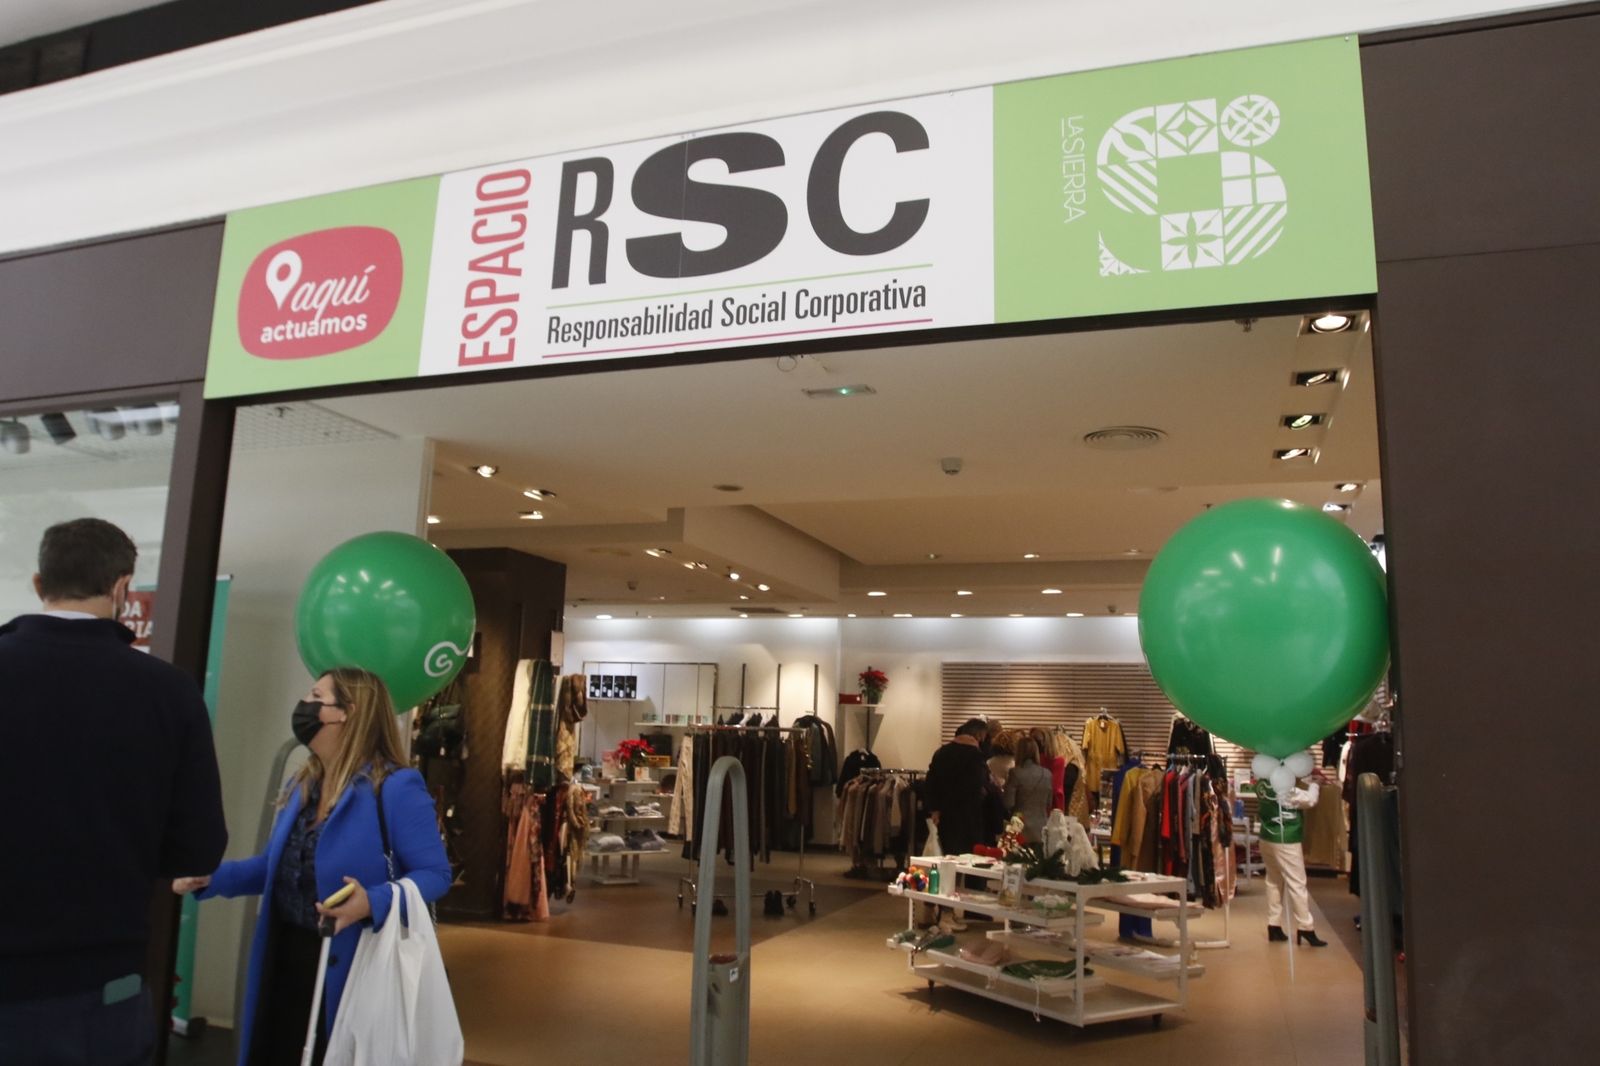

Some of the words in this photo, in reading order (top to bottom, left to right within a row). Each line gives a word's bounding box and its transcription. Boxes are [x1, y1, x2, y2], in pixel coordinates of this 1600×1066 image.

[551, 110, 931, 290] RSC
[290, 264, 376, 322] aquí
[458, 169, 532, 367] ESPACIO
[260, 313, 368, 344] actuamos
[546, 299, 713, 348] Responsabilidad
[721, 290, 787, 327] Social
[794, 279, 927, 323] Corporativa
